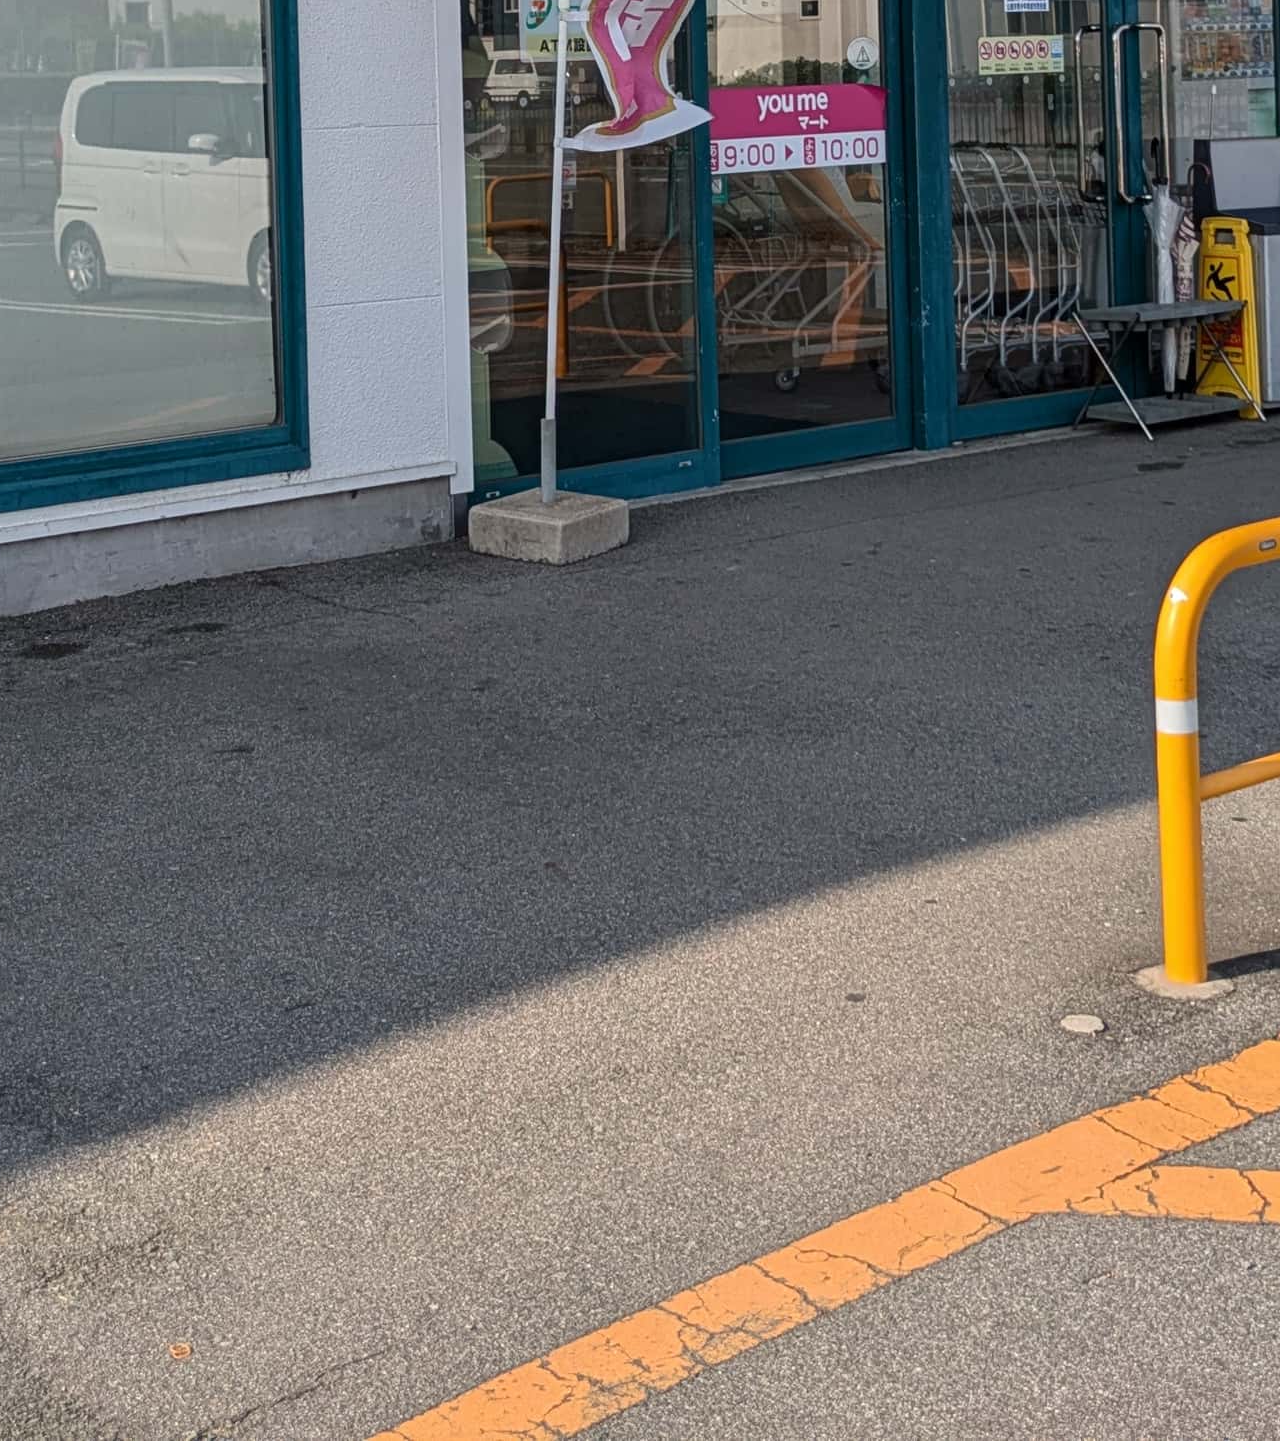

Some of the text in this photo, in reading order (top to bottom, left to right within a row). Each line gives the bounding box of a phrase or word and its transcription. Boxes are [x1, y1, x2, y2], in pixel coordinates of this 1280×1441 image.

[798, 114, 829, 130] マート
[724, 143, 776, 168] 9:00
[821, 136, 879, 161] 10:00
